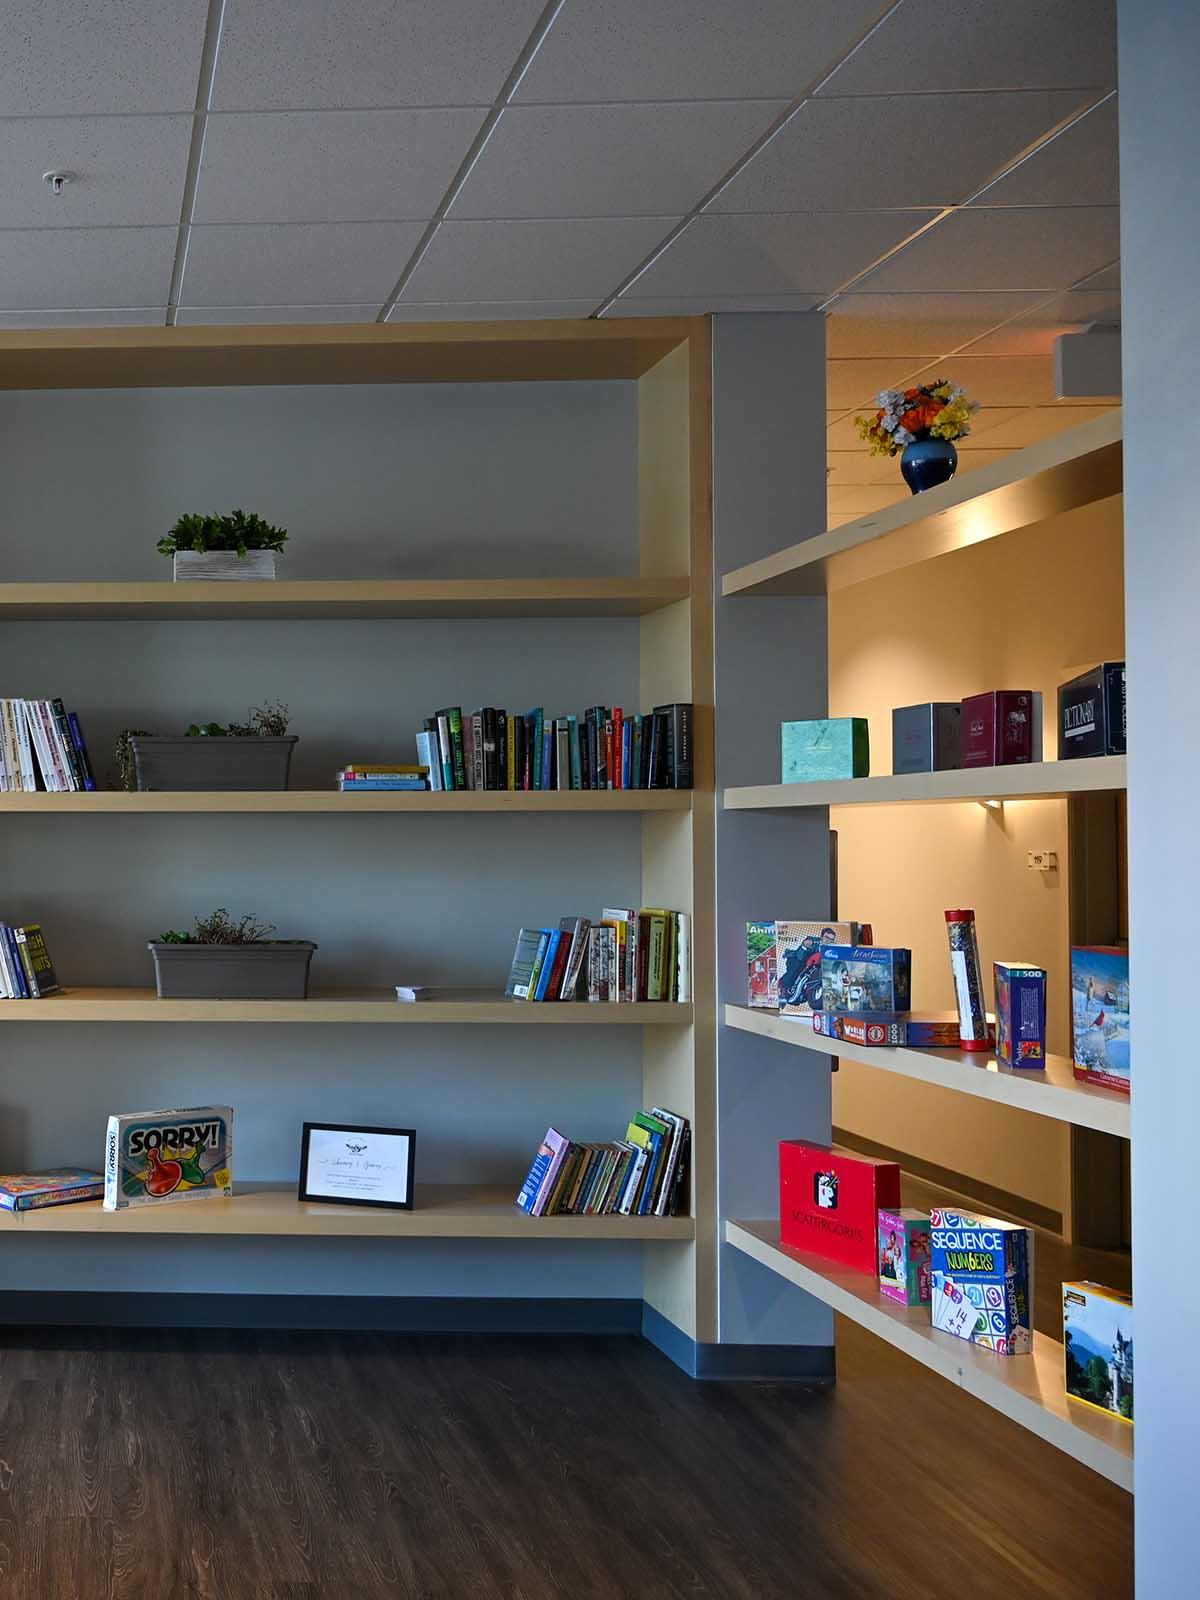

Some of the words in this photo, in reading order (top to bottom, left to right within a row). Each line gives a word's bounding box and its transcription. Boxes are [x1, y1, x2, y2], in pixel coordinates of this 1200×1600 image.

[1023, 970, 1042, 978] 500
[129, 1122, 219, 1156] SORRY!
[931, 1231, 1003, 1251] SEQUENCE
[1007, 1278, 1019, 1324] SEQUENCE
[956, 1308, 968, 1324] 14
